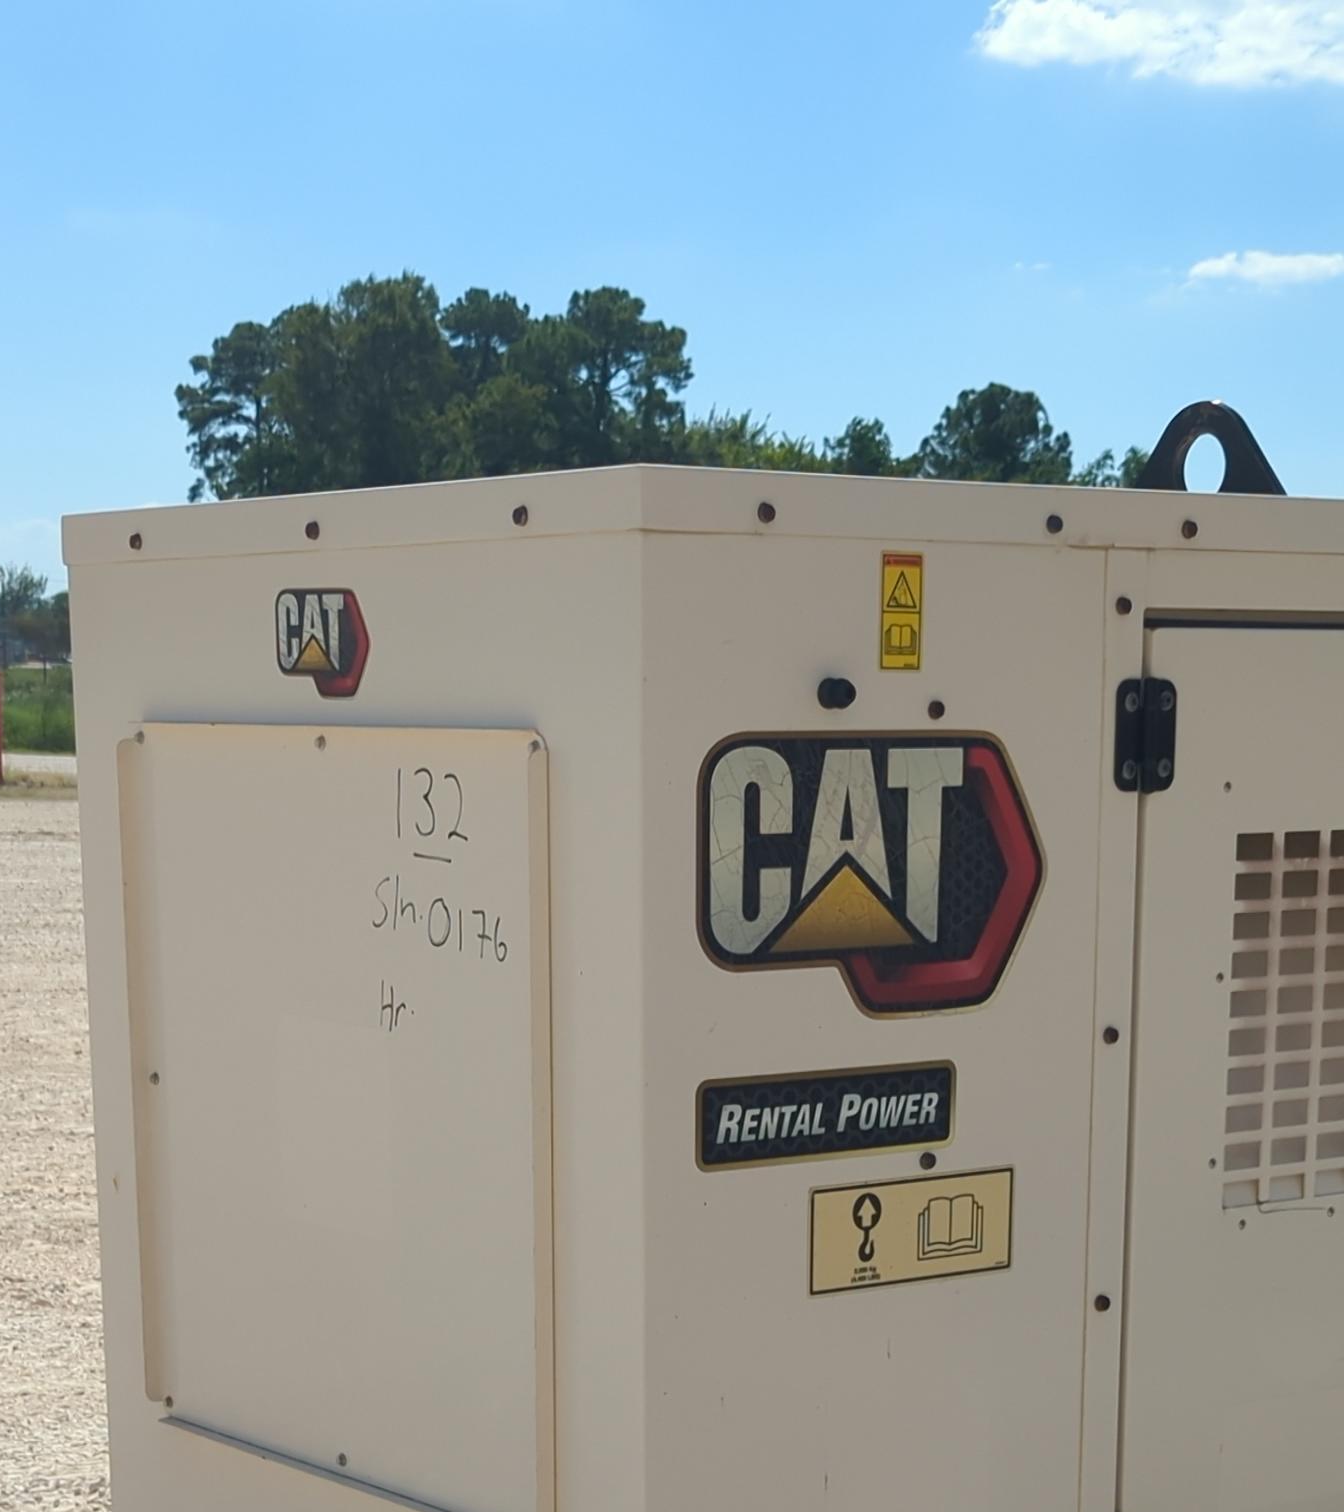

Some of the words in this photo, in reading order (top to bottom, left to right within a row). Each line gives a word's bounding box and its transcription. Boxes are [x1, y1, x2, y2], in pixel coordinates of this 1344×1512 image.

[277, 592, 344, 671] CAT
[396, 767, 469, 843] 132
[709, 745, 964, 955] CAT
[715, 1102, 827, 1145] RENTAL
[836, 1091, 940, 1134] POWER
